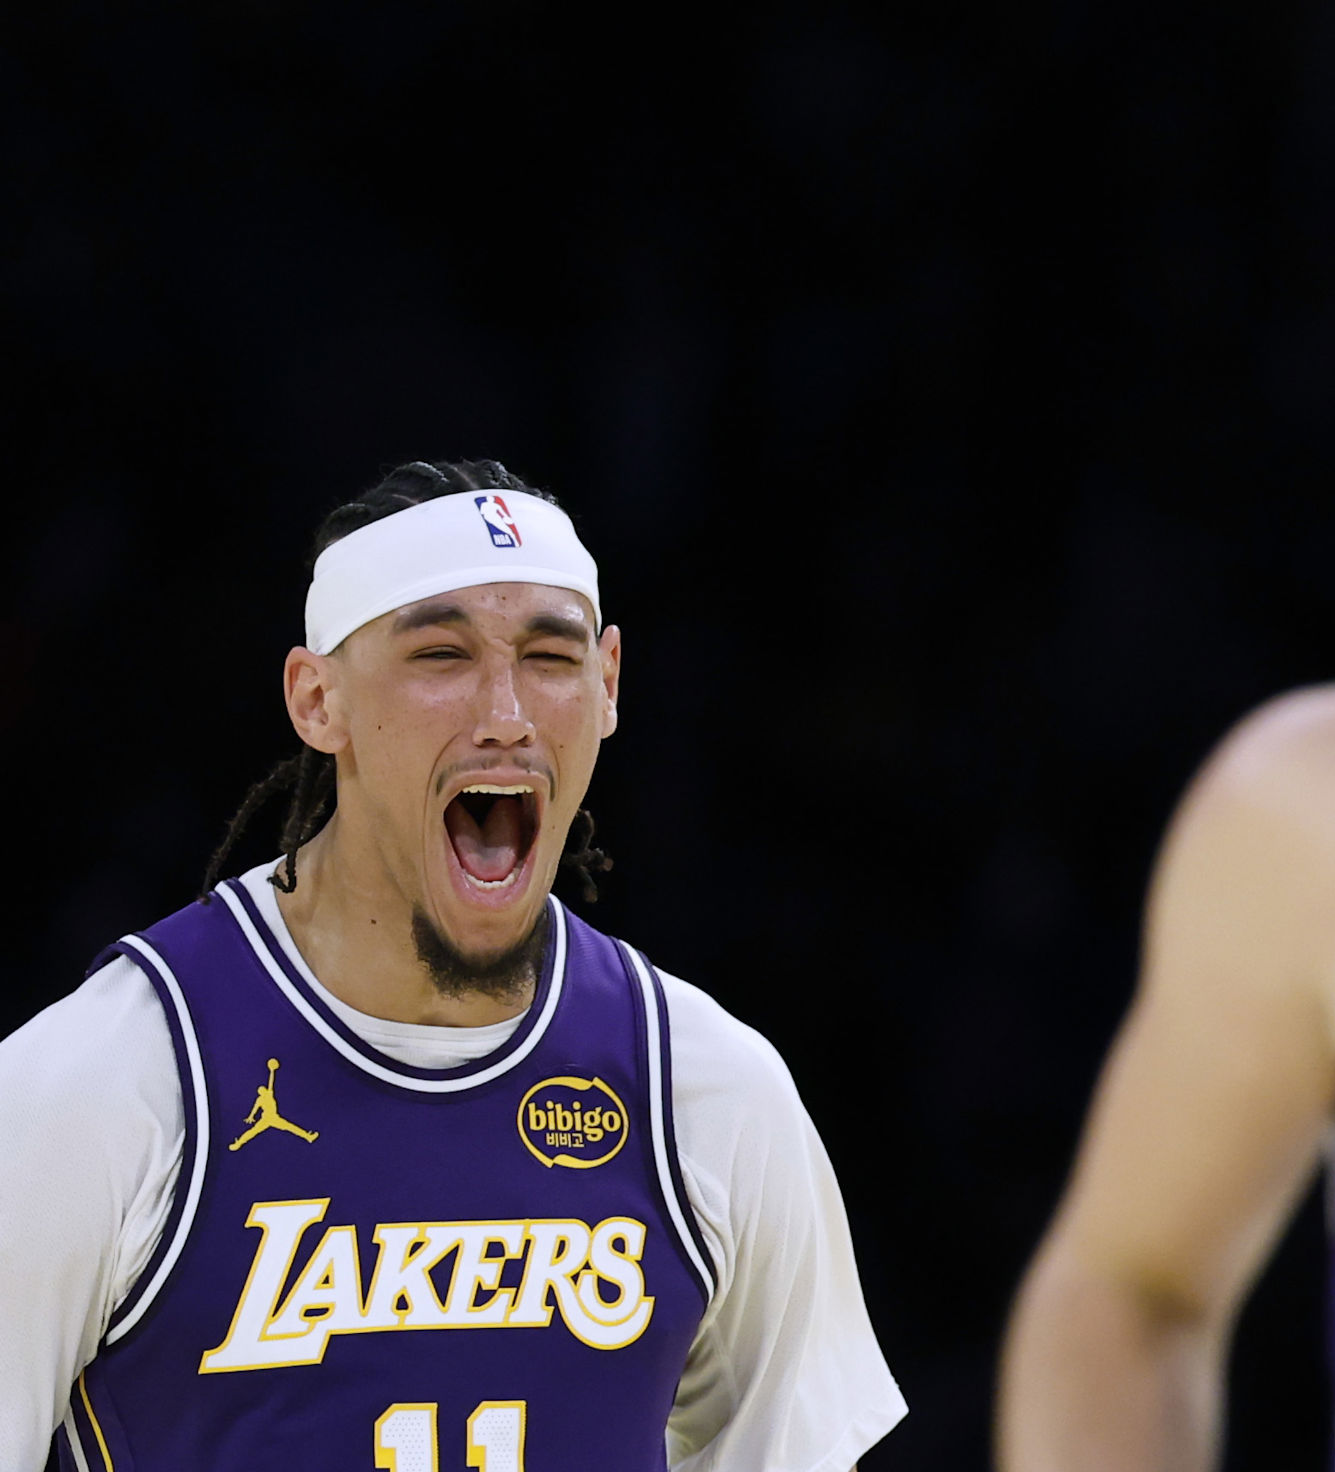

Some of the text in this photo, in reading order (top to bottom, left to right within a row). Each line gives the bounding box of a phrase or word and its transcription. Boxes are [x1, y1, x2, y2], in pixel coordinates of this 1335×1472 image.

[528, 1100, 621, 1142] bibigo
[546, 1132, 585, 1148] 비비고
[198, 1197, 655, 1374] LAKERS
